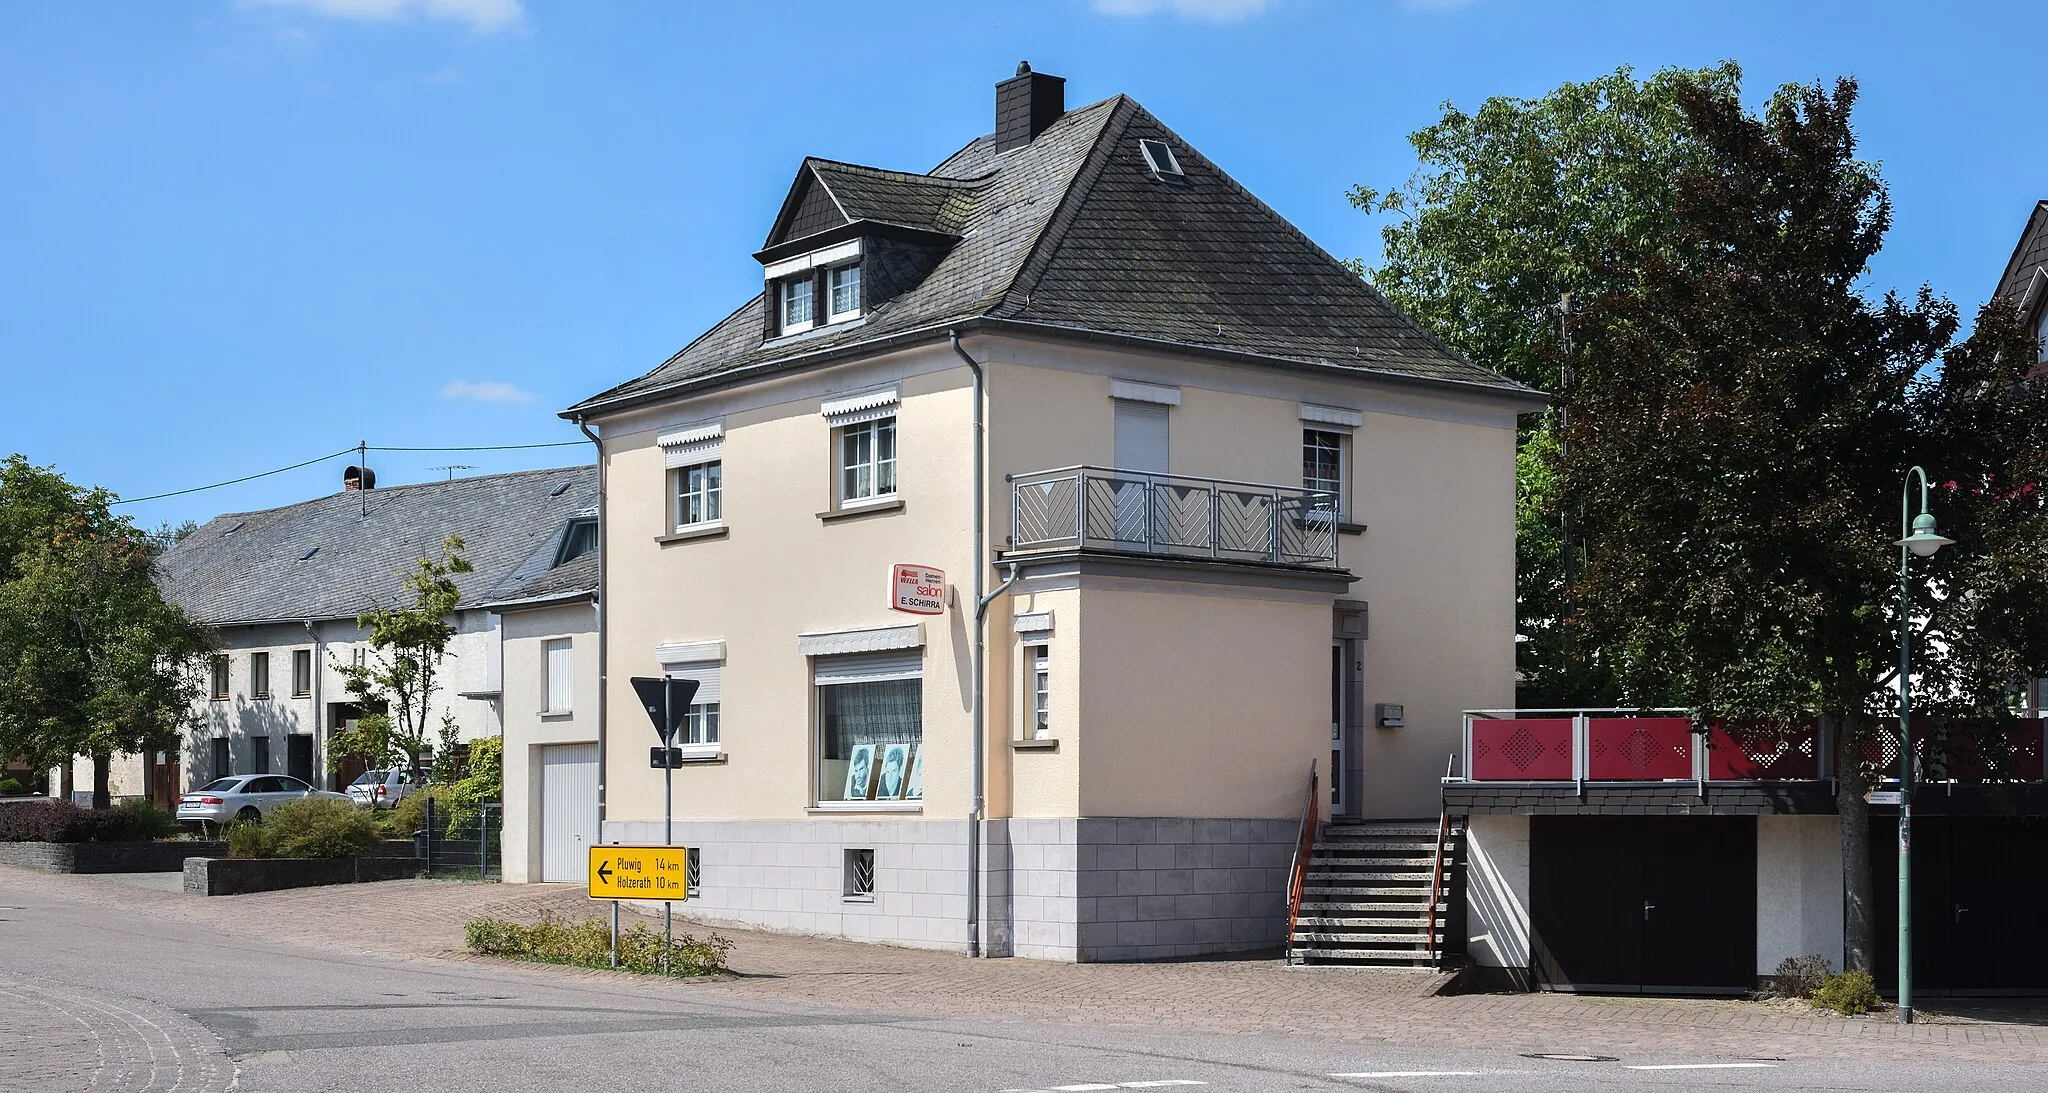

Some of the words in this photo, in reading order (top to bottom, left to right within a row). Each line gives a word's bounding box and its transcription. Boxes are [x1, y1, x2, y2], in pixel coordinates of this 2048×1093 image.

[916, 583, 942, 597] salon
[901, 597, 907, 605] E.
[908, 598, 940, 609] SCHIRRA
[1356, 661, 1361, 671] 2
[617, 858, 641, 873] Pluwig
[656, 858, 665, 871] 14
[668, 861, 680, 871] km
[617, 876, 651, 889] Holzerath
[656, 876, 665, 889] 10
[668, 880, 680, 889] km
